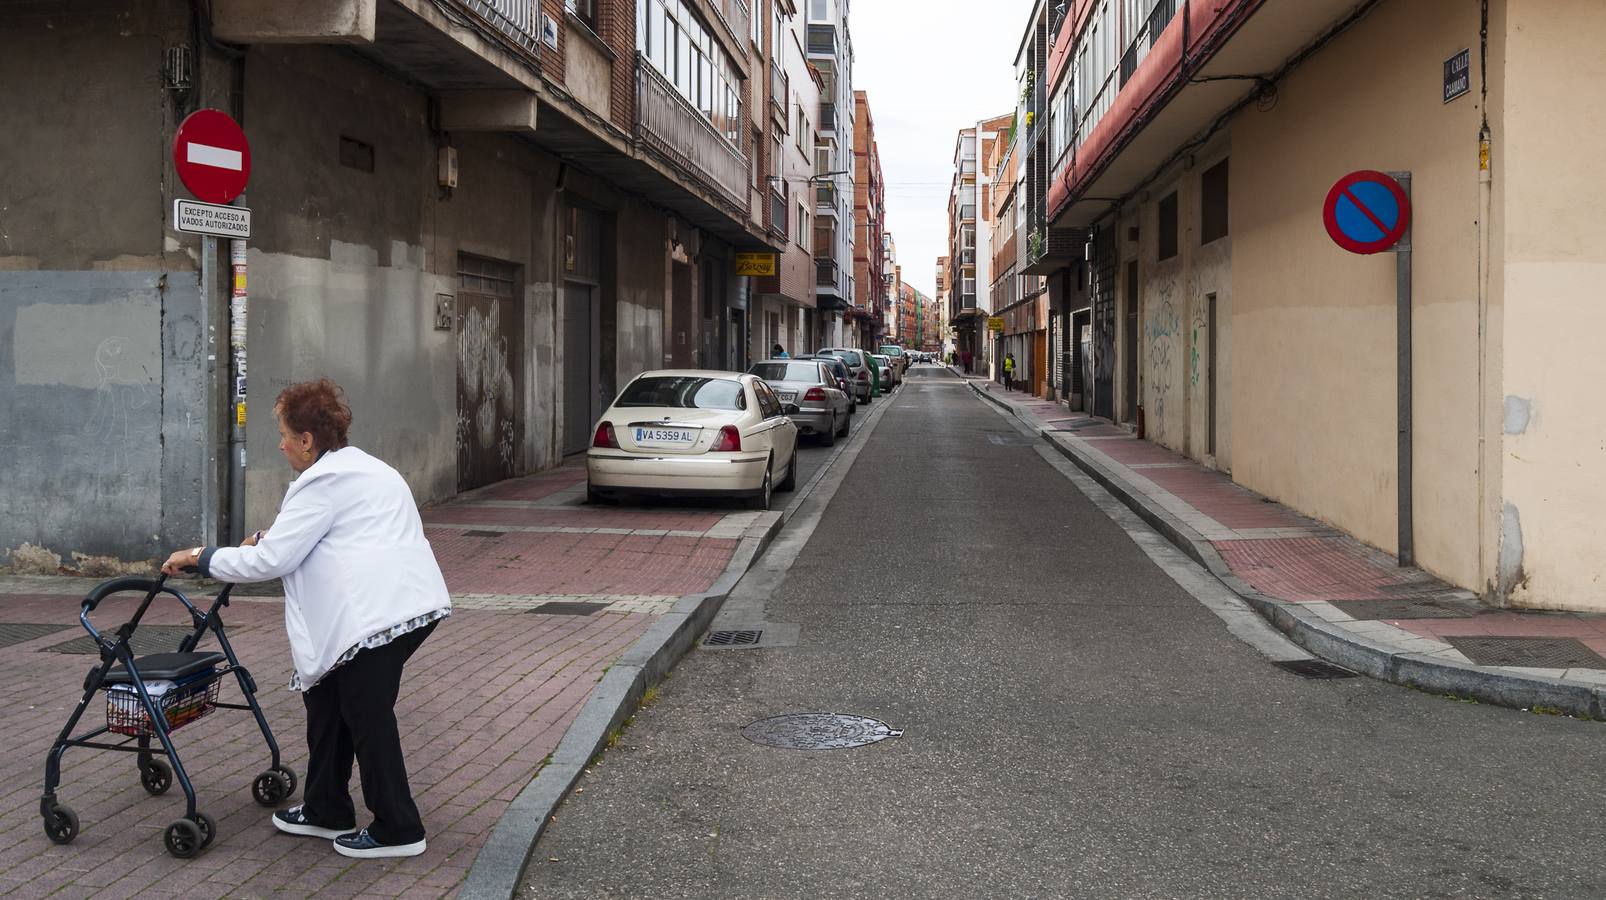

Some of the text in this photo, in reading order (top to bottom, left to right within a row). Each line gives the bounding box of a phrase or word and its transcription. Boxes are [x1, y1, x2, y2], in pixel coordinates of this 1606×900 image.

[1451, 53, 1469, 74] CALLE
[1446, 74, 1466, 98] CAAMAÑO
[184, 207, 213, 218] EXCEPTO
[214, 211, 239, 222] ACCESO
[181, 217, 249, 232] VADOS AUTORIZADOS
[642, 430, 693, 442] VA 5359 AL
